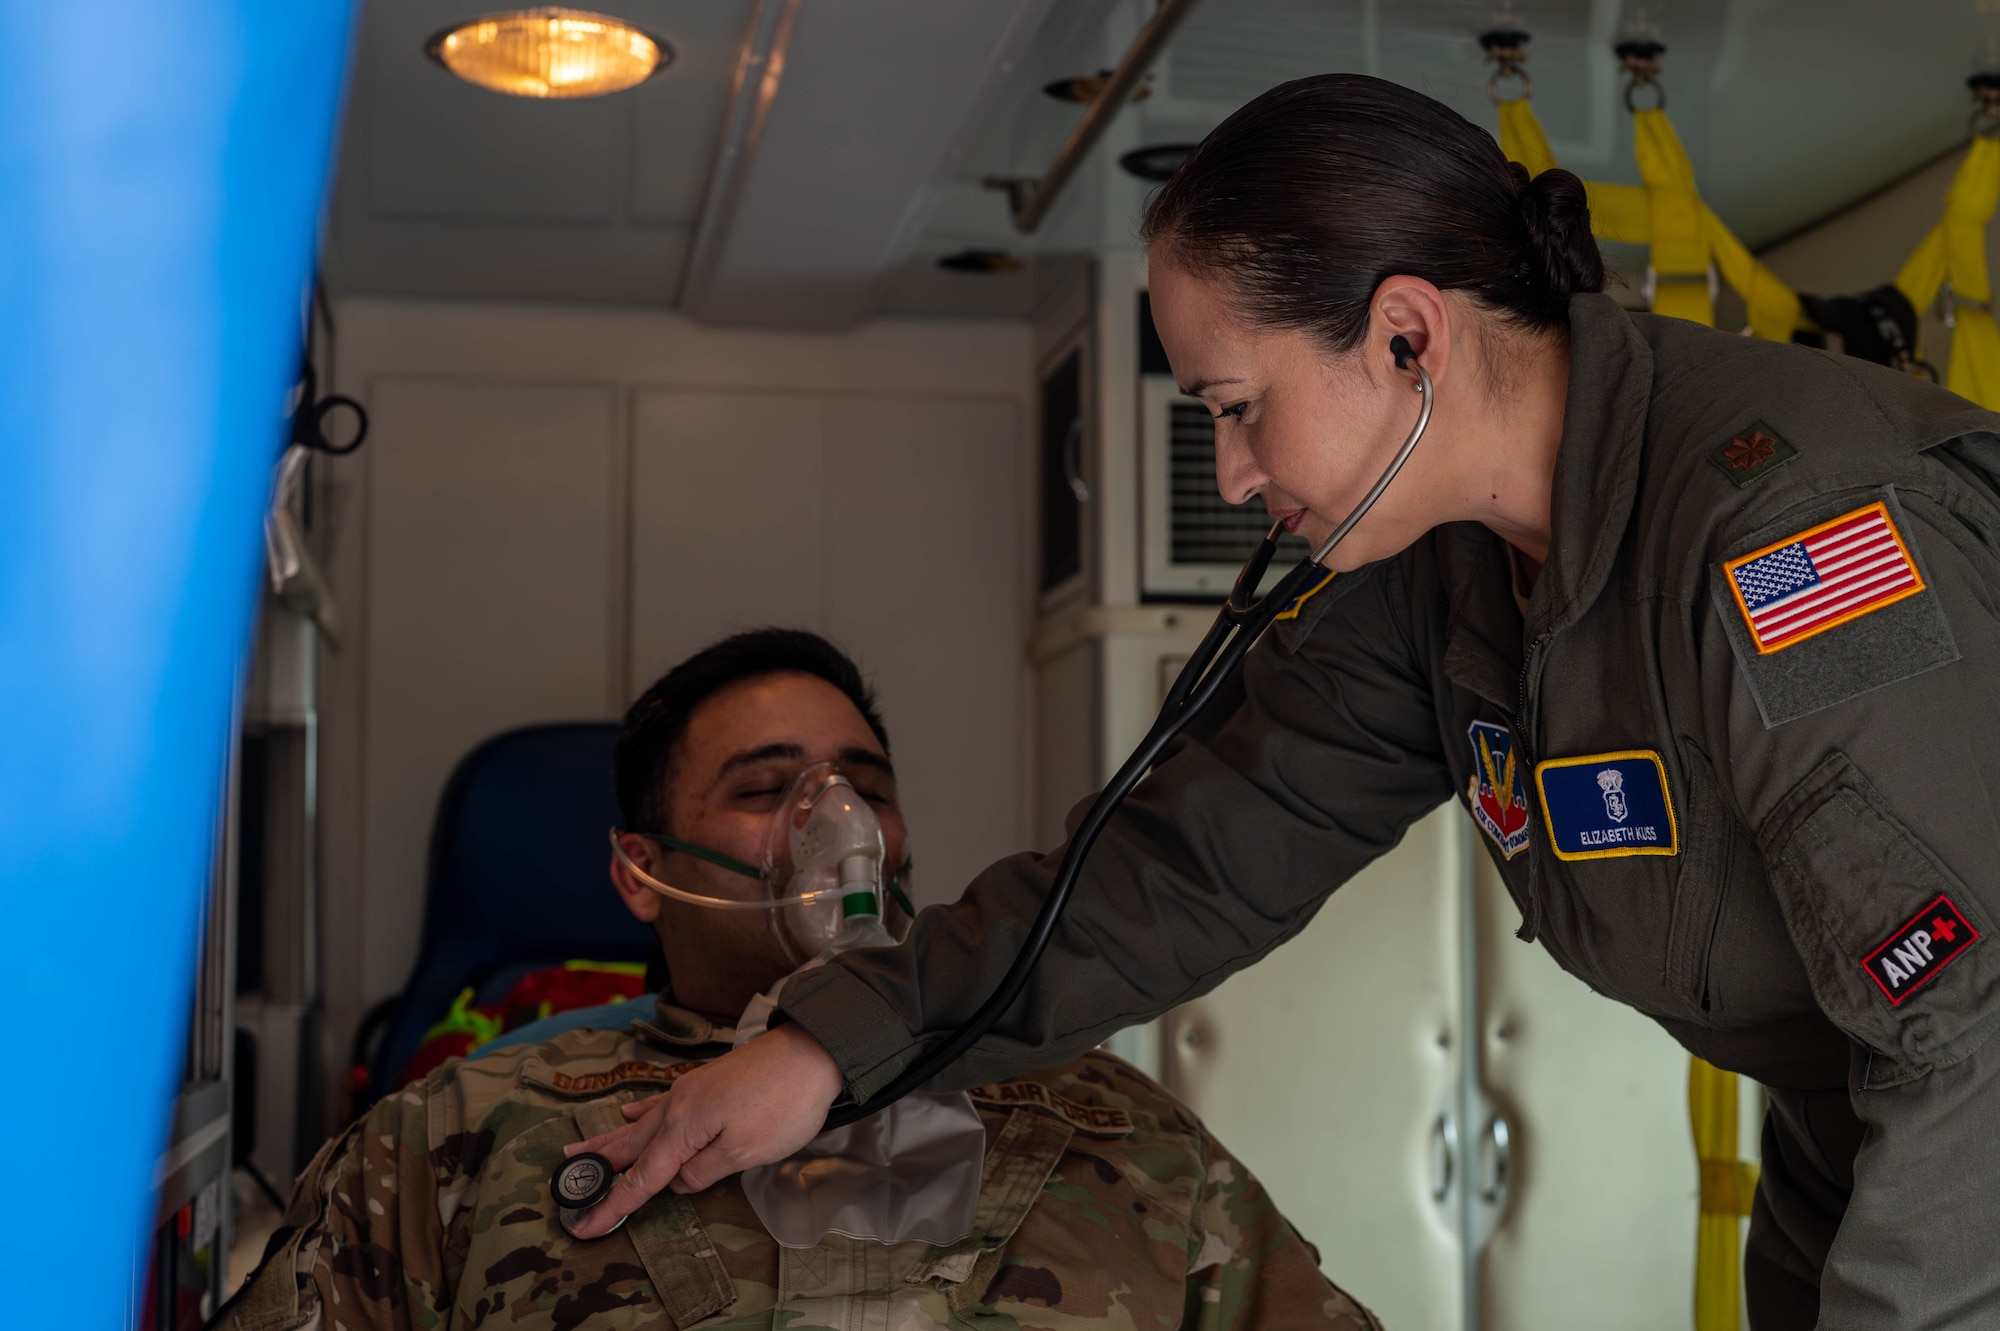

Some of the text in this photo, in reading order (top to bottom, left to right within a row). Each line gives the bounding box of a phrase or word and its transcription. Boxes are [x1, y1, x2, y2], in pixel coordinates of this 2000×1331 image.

[1475, 806, 1487, 825] AIR
[1580, 826, 1657, 845] ELIZABETH KUSS
[1881, 930, 1934, 988] ANP
[1001, 1084, 1045, 1102] AIR
[1048, 1091, 1128, 1127] FORCE
